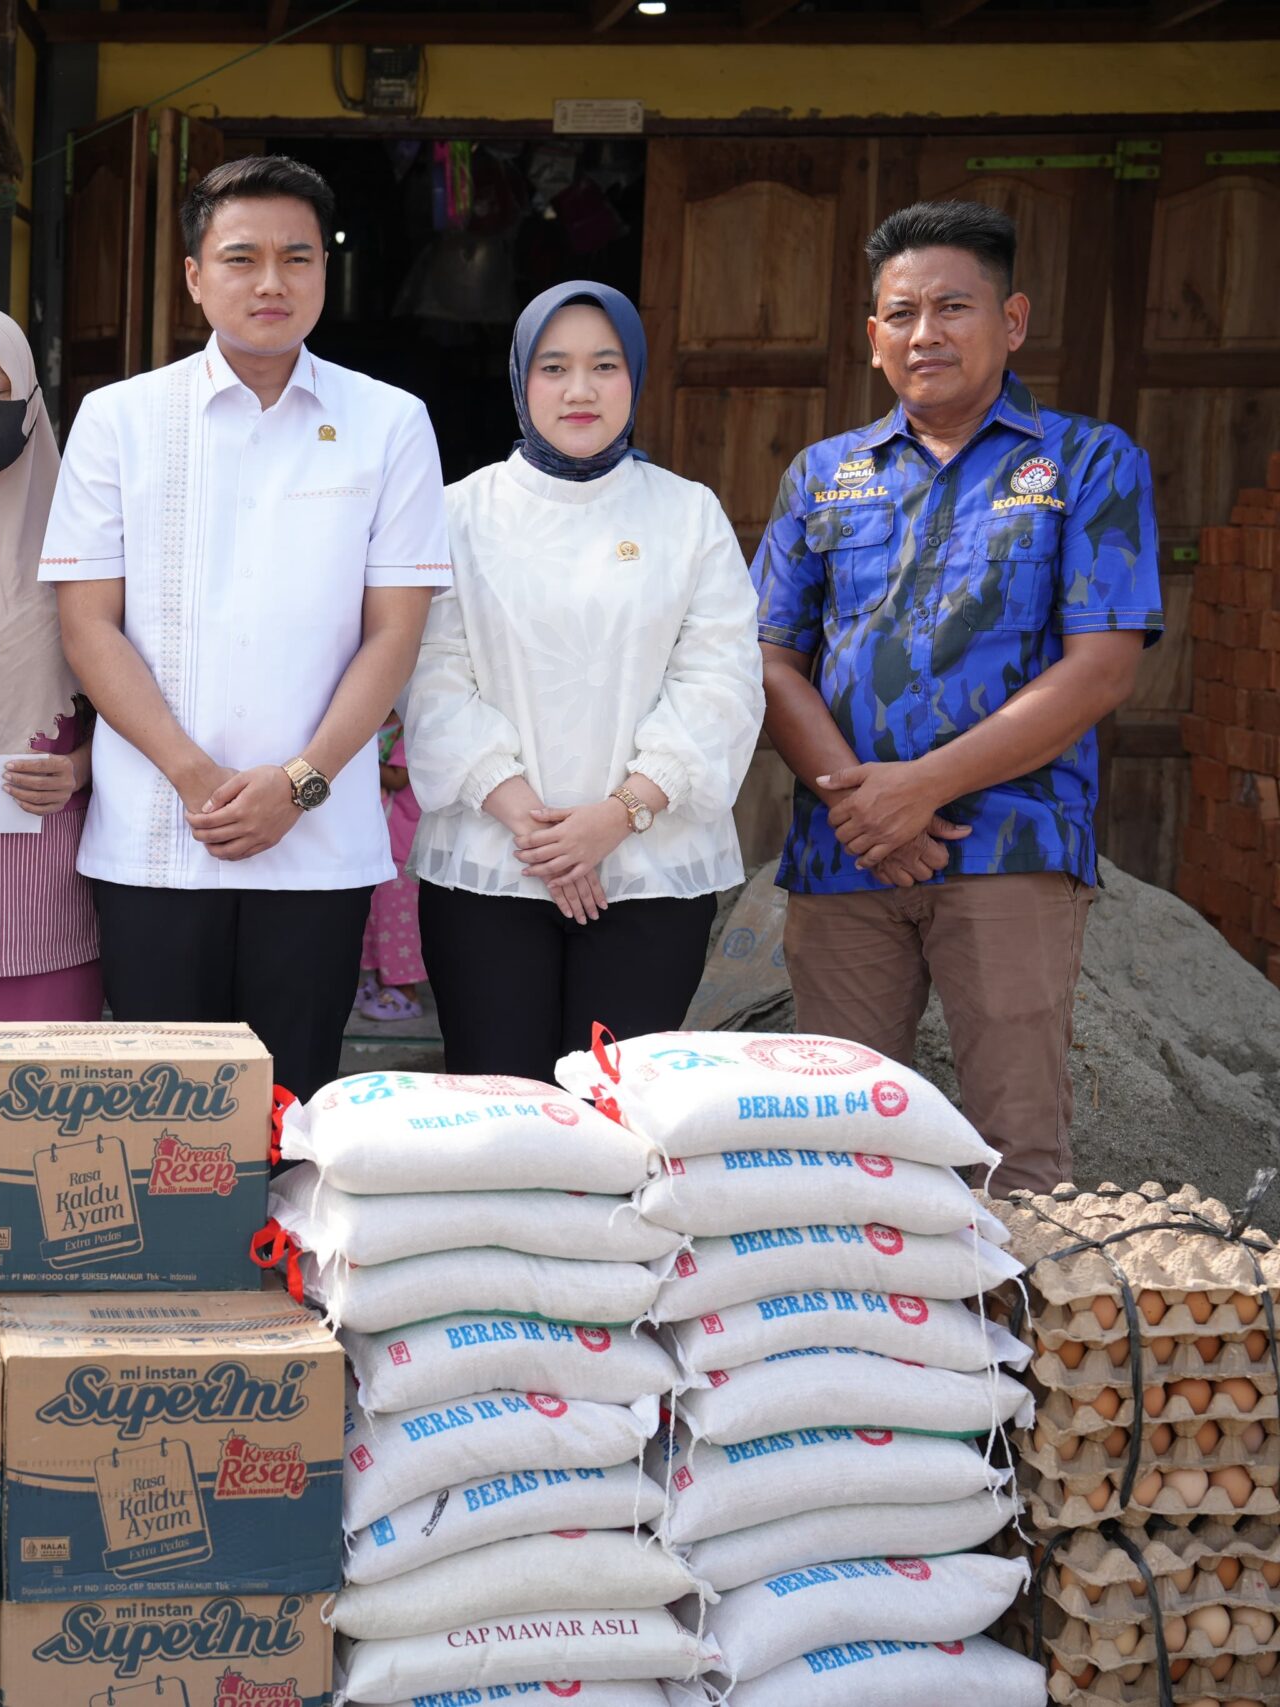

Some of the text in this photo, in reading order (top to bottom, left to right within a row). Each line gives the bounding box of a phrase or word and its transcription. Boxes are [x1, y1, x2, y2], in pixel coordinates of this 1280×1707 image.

[814, 486, 888, 503] KOPRAL
[992, 495, 1065, 511] KOMBAT
[60, 1066, 133, 1079] mi instan
[408, 1103, 540, 1131] BERAS IR 64
[738, 1090, 869, 1119] BERAS IR 64
[174, 1143, 227, 1164] Kreasi
[722, 1150, 853, 1170] BERAS IR 64
[70, 1170, 101, 1187] Rasa
[152, 1158, 235, 1189] Resep
[56, 1182, 120, 1212] Kaldu
[62, 1203, 125, 1233] Ayam
[65, 1229, 122, 1252] Extra Pedas
[732, 1224, 864, 1256] BERAS IR 64
[759, 1291, 888, 1321] BERAS IR 64
[445, 1322, 573, 1349] BERAS IR 64
[120, 1366, 197, 1380] mi instan
[36, 1360, 308, 1440] SuperMi
[401, 1396, 531, 1443] BERAS IR 64
[243, 1443, 300, 1463] Kreasi
[723, 1429, 855, 1465] BERAS IR 64
[132, 1474, 166, 1492] Rasa
[219, 1458, 306, 1490] Resep
[119, 1488, 186, 1520] Kaldu
[464, 1470, 540, 1512] BERAS
[543, 1469, 570, 1487] IR
[125, 1509, 192, 1541] Ayam
[40, 1543, 67, 1551] HALAL
[128, 1537, 191, 1561] Extra Pedas
[147, 1583, 175, 1591] SUKSES
[177, 1582, 212, 1590] MAKMUR
[765, 1561, 840, 1597] BERAS
[115, 1603, 193, 1618] mi instan
[33, 1594, 304, 1679] SuperMi
[447, 1619, 640, 1649] CAP MAWAR ASLI
[802, 1640, 876, 1675] BERAS
[238, 1679, 294, 1700] Kreasi
